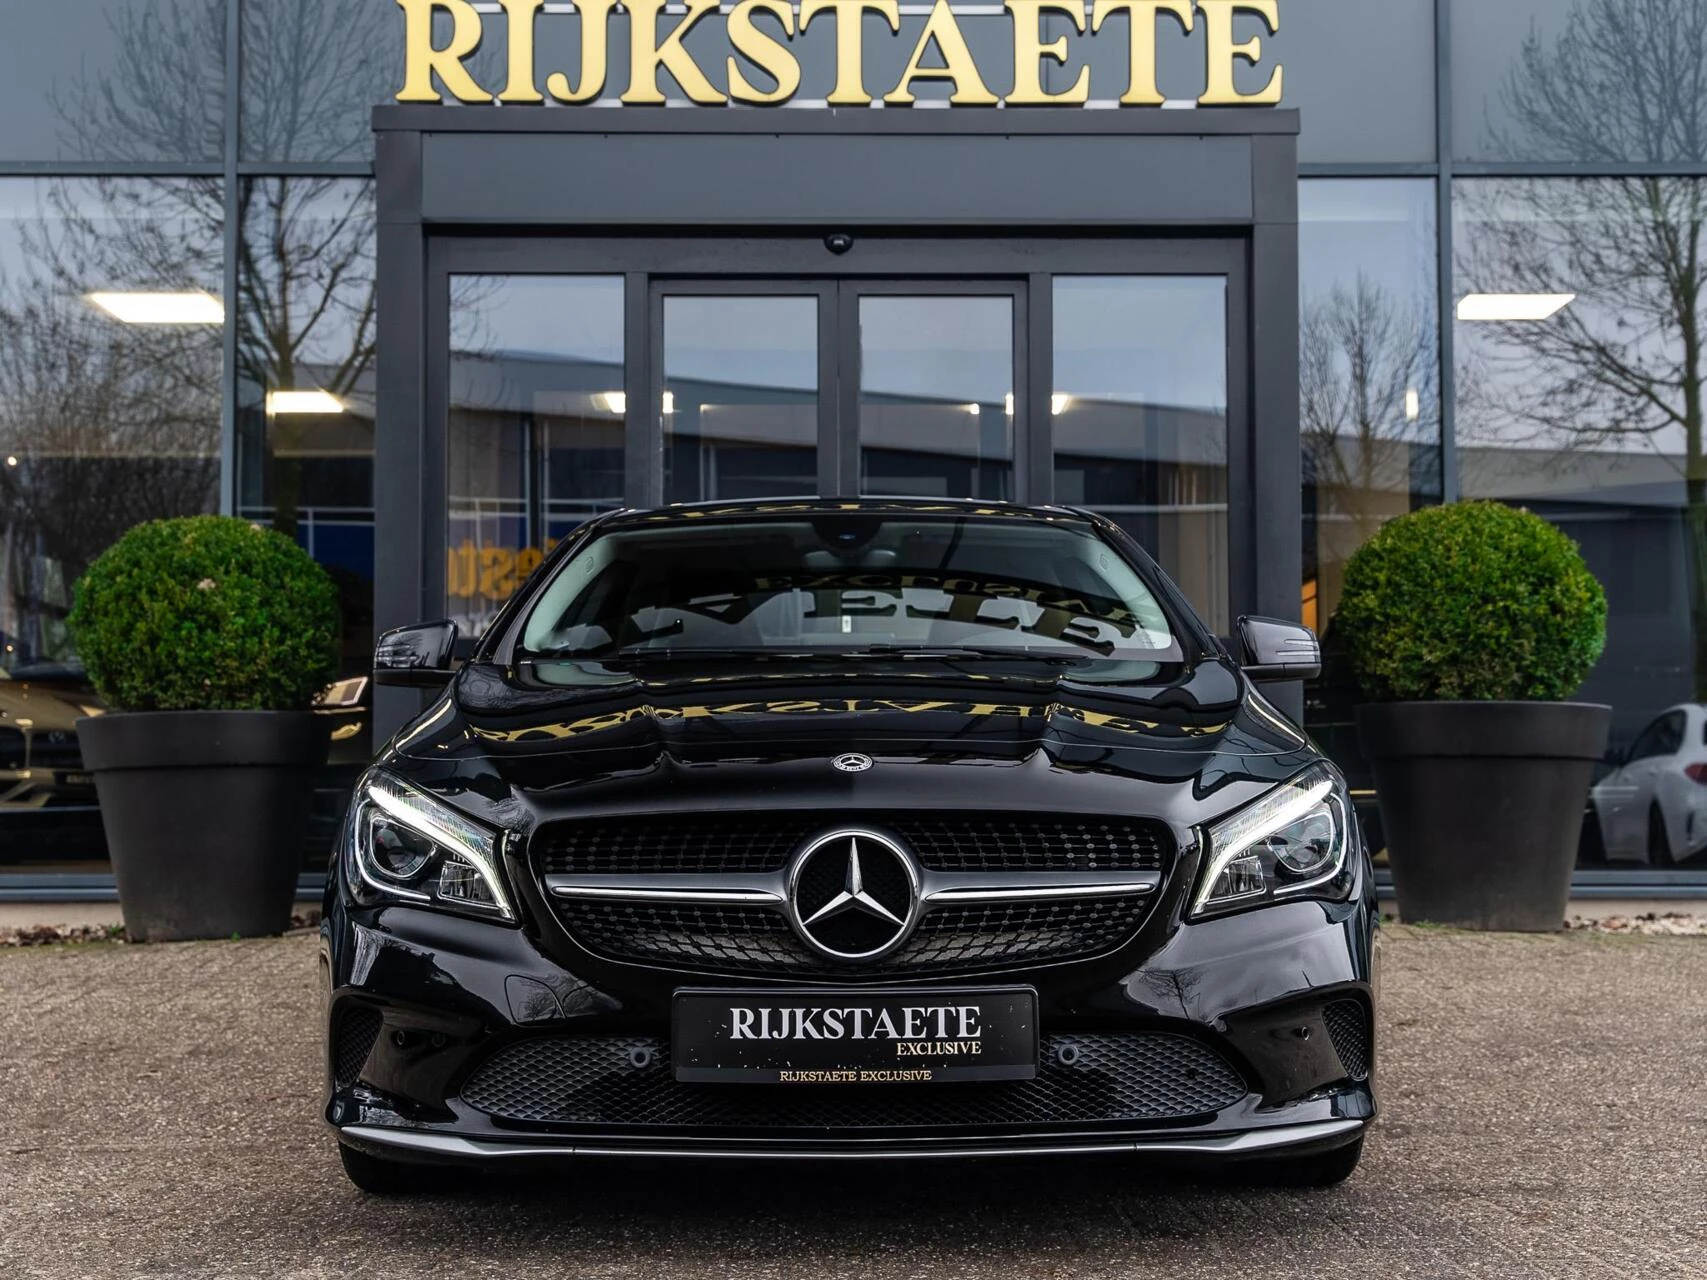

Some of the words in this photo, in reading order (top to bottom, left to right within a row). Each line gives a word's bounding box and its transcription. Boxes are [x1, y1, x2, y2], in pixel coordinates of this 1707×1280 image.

[395, 0, 1284, 105] RIJKSTAETE
[729, 1006, 981, 1040] RIJKSTAETE
[896, 1041, 981, 1056] EXCLUSIVE
[779, 1071, 857, 1082] RIJKSTAETE
[860, 1070, 933, 1081] EXCLUSIVE
